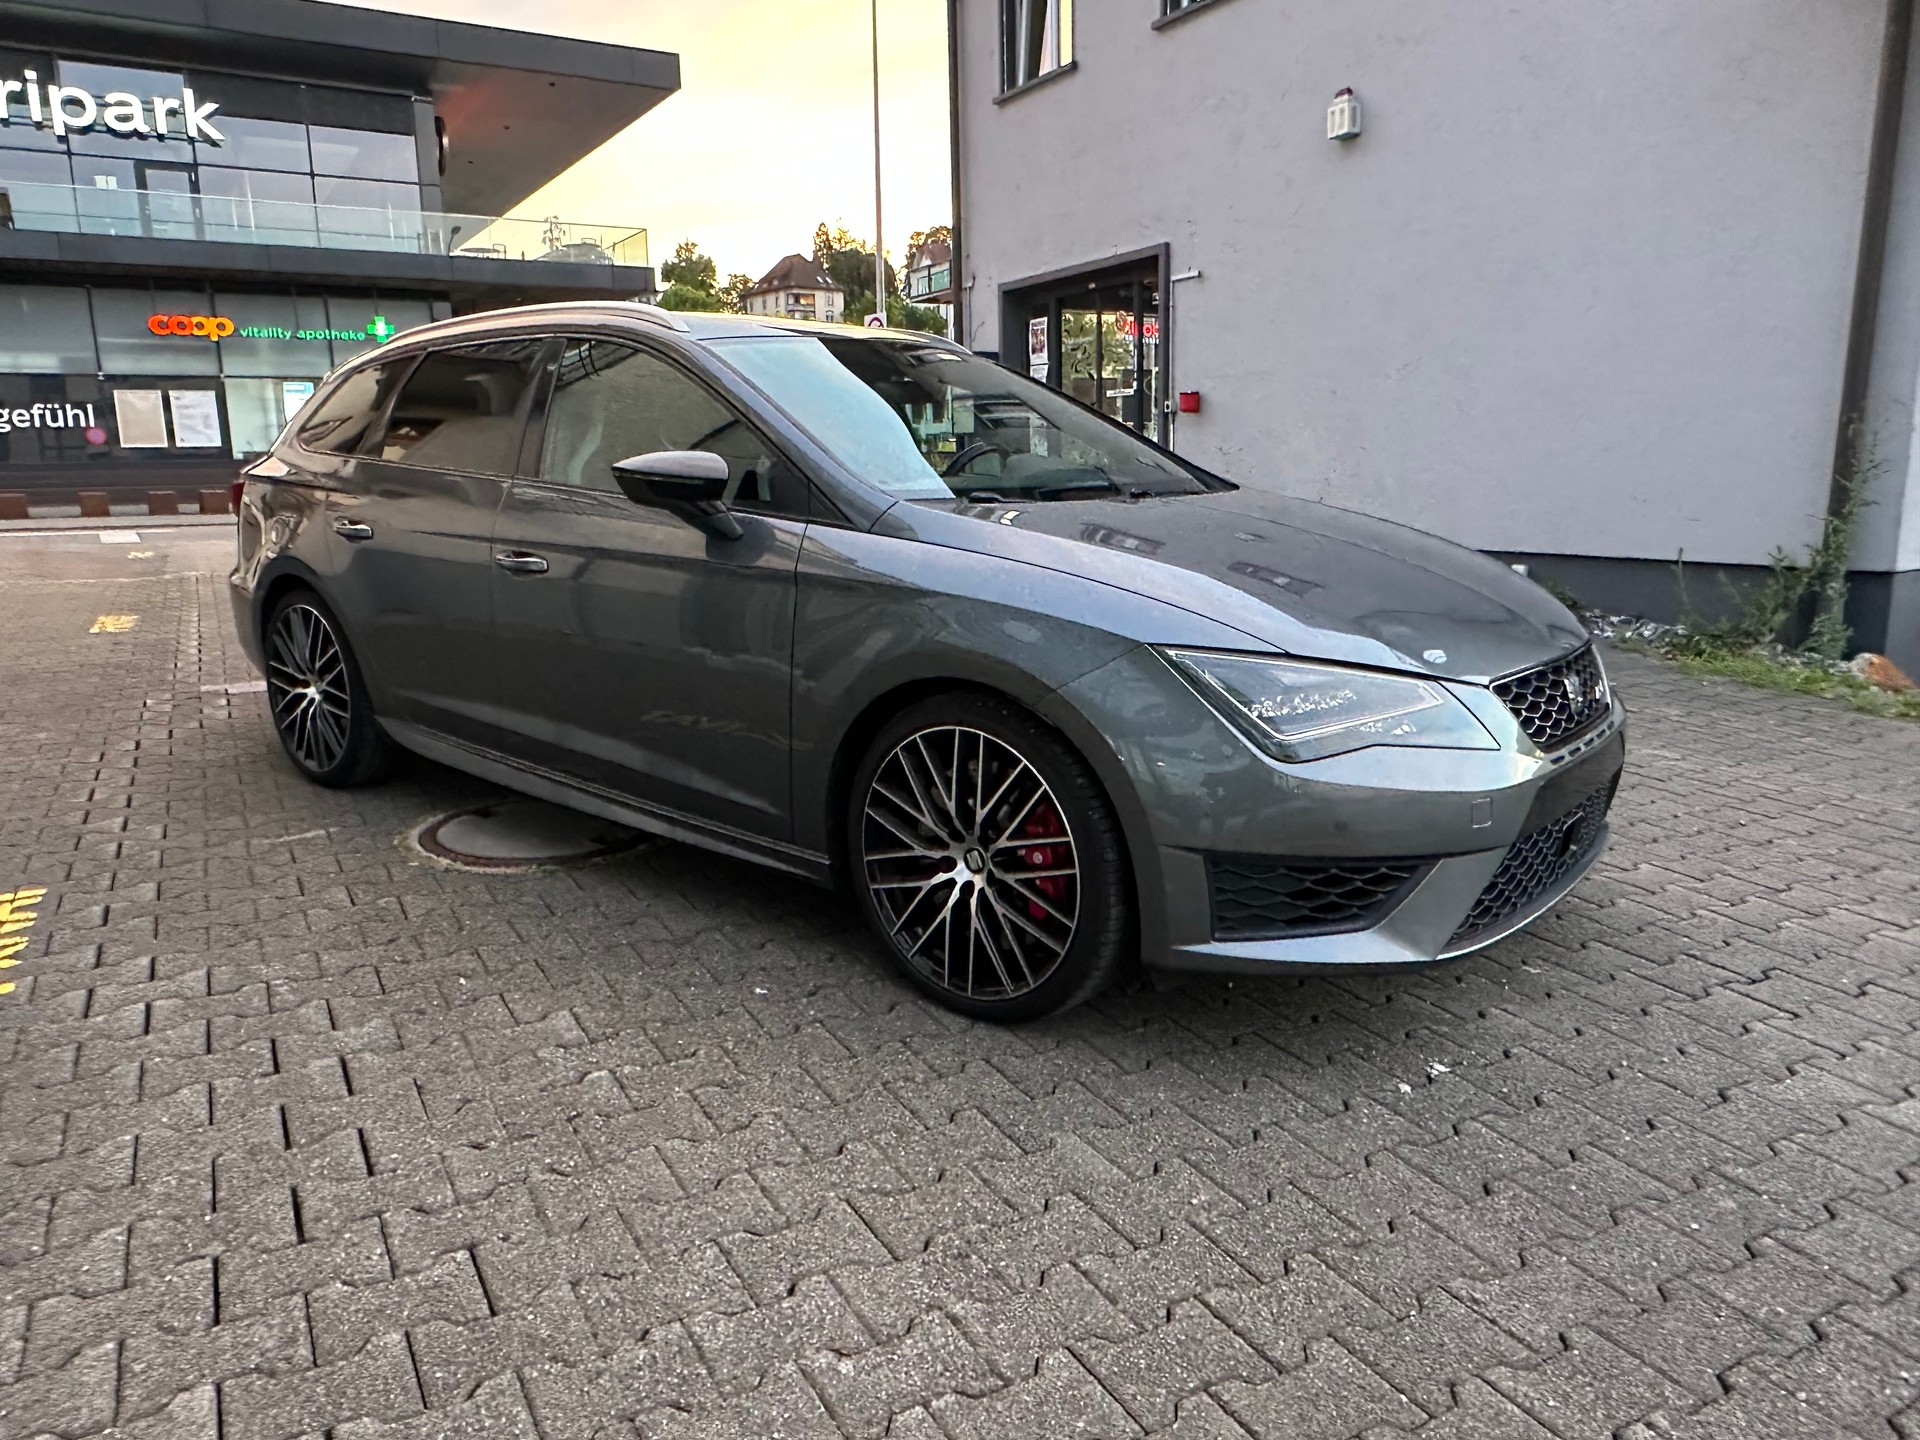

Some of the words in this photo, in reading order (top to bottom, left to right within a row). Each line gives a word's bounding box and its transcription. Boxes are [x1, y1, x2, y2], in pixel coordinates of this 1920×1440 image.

[0, 69, 225, 141] ripark
[148, 314, 234, 341] coop
[239, 326, 292, 340] vitality
[296, 329, 365, 341] apotheke
